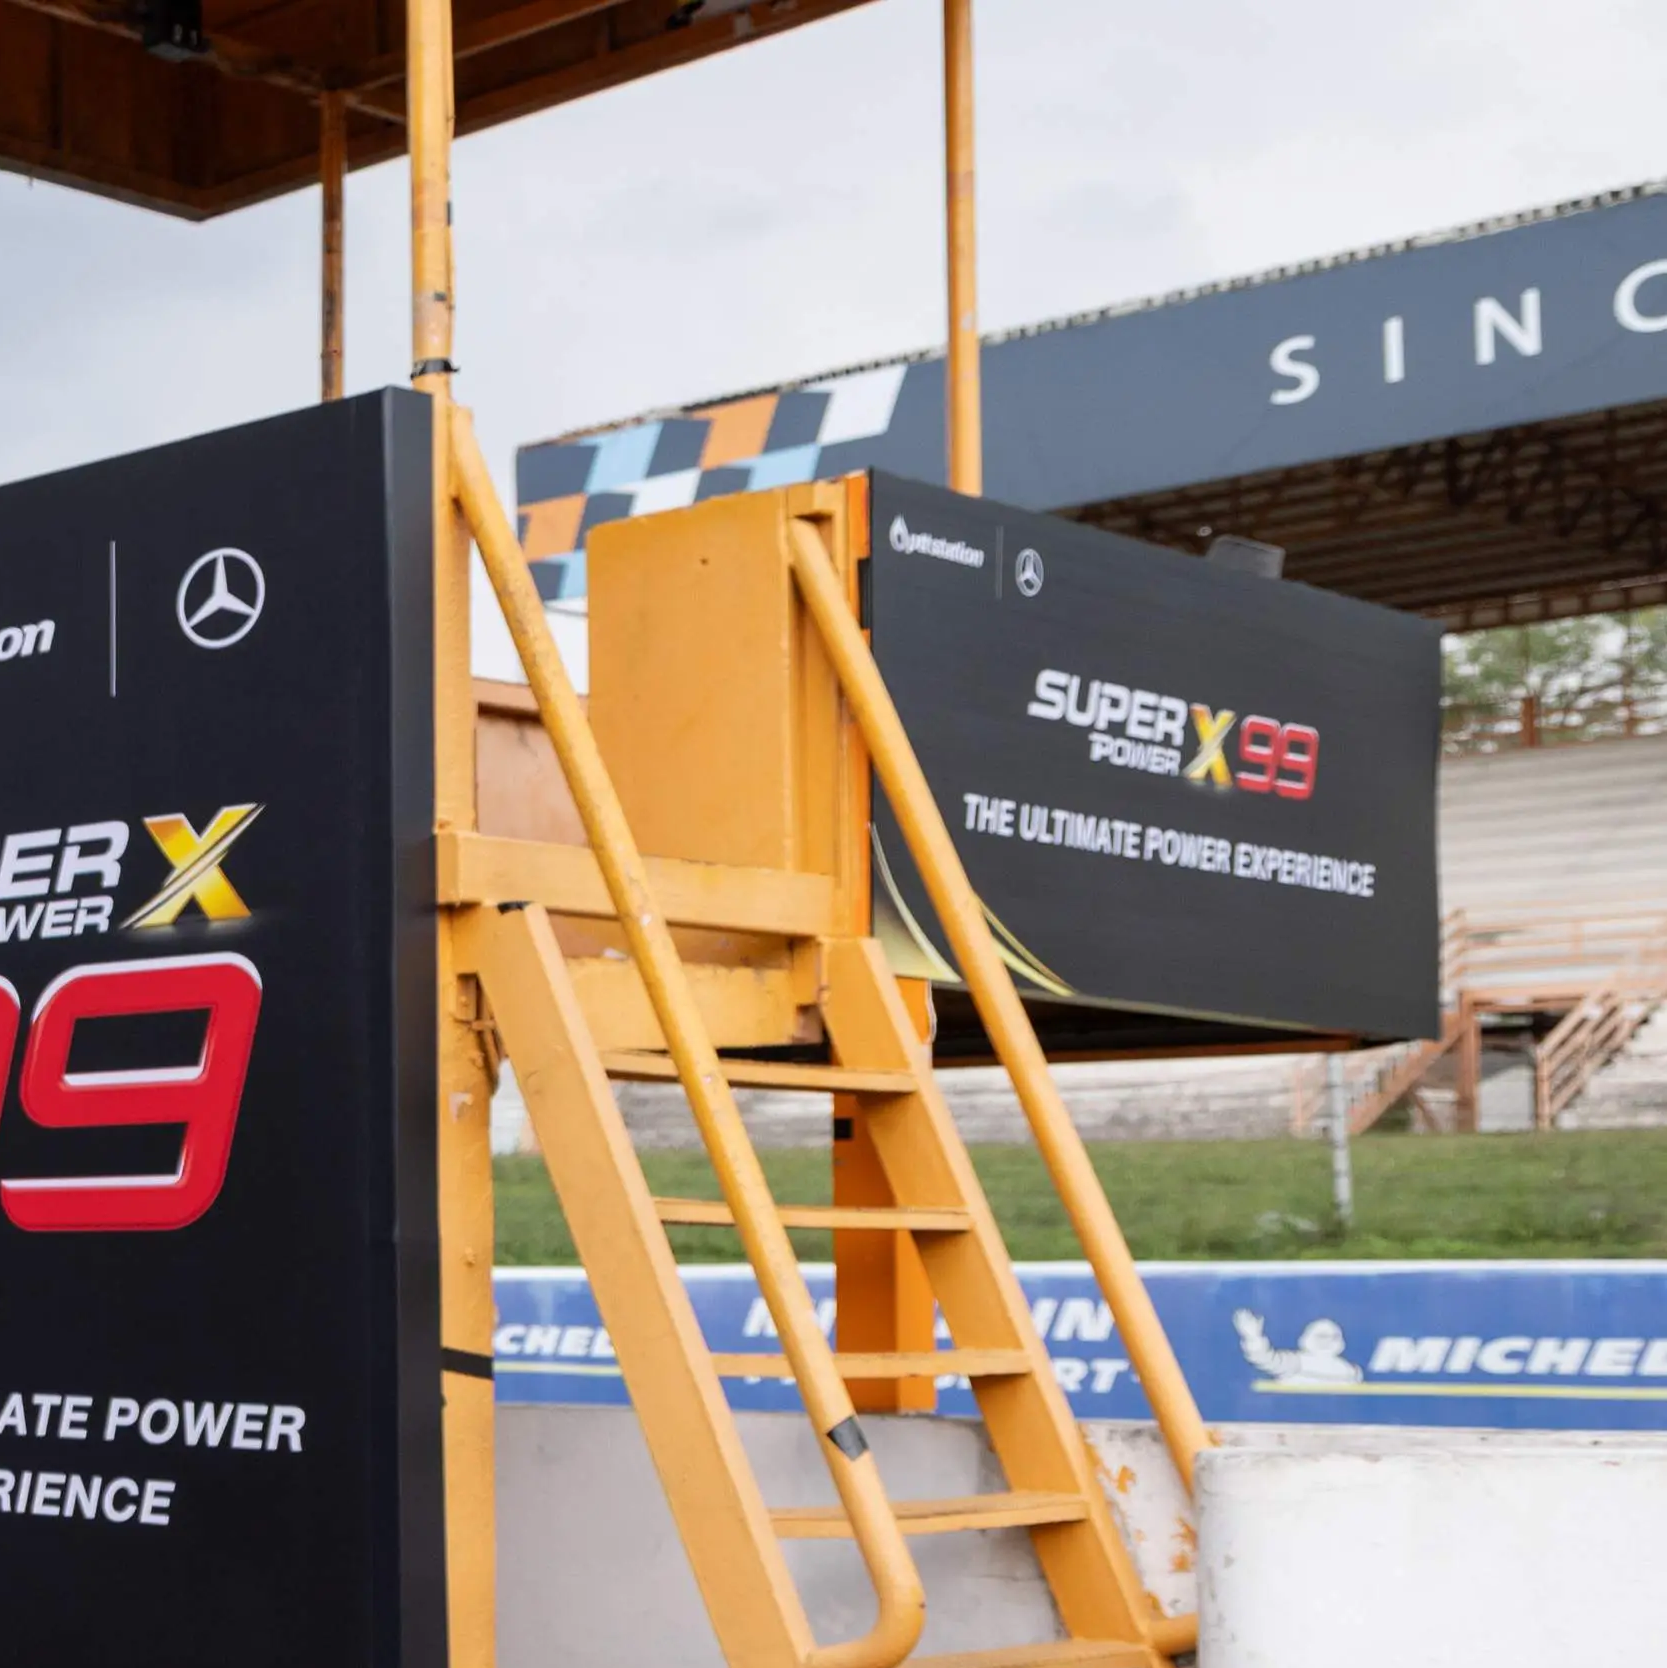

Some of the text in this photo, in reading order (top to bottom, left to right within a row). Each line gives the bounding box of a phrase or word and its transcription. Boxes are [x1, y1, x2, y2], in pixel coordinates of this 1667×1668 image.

[1027, 668, 1320, 801] SUPER X 99
[1088, 731, 1182, 777] POWER
[118, 801, 266, 929] X
[964, 793, 1377, 898] THE ULTIMATE POWER EXPERIENCE
[103, 1397, 307, 1452] POWER
